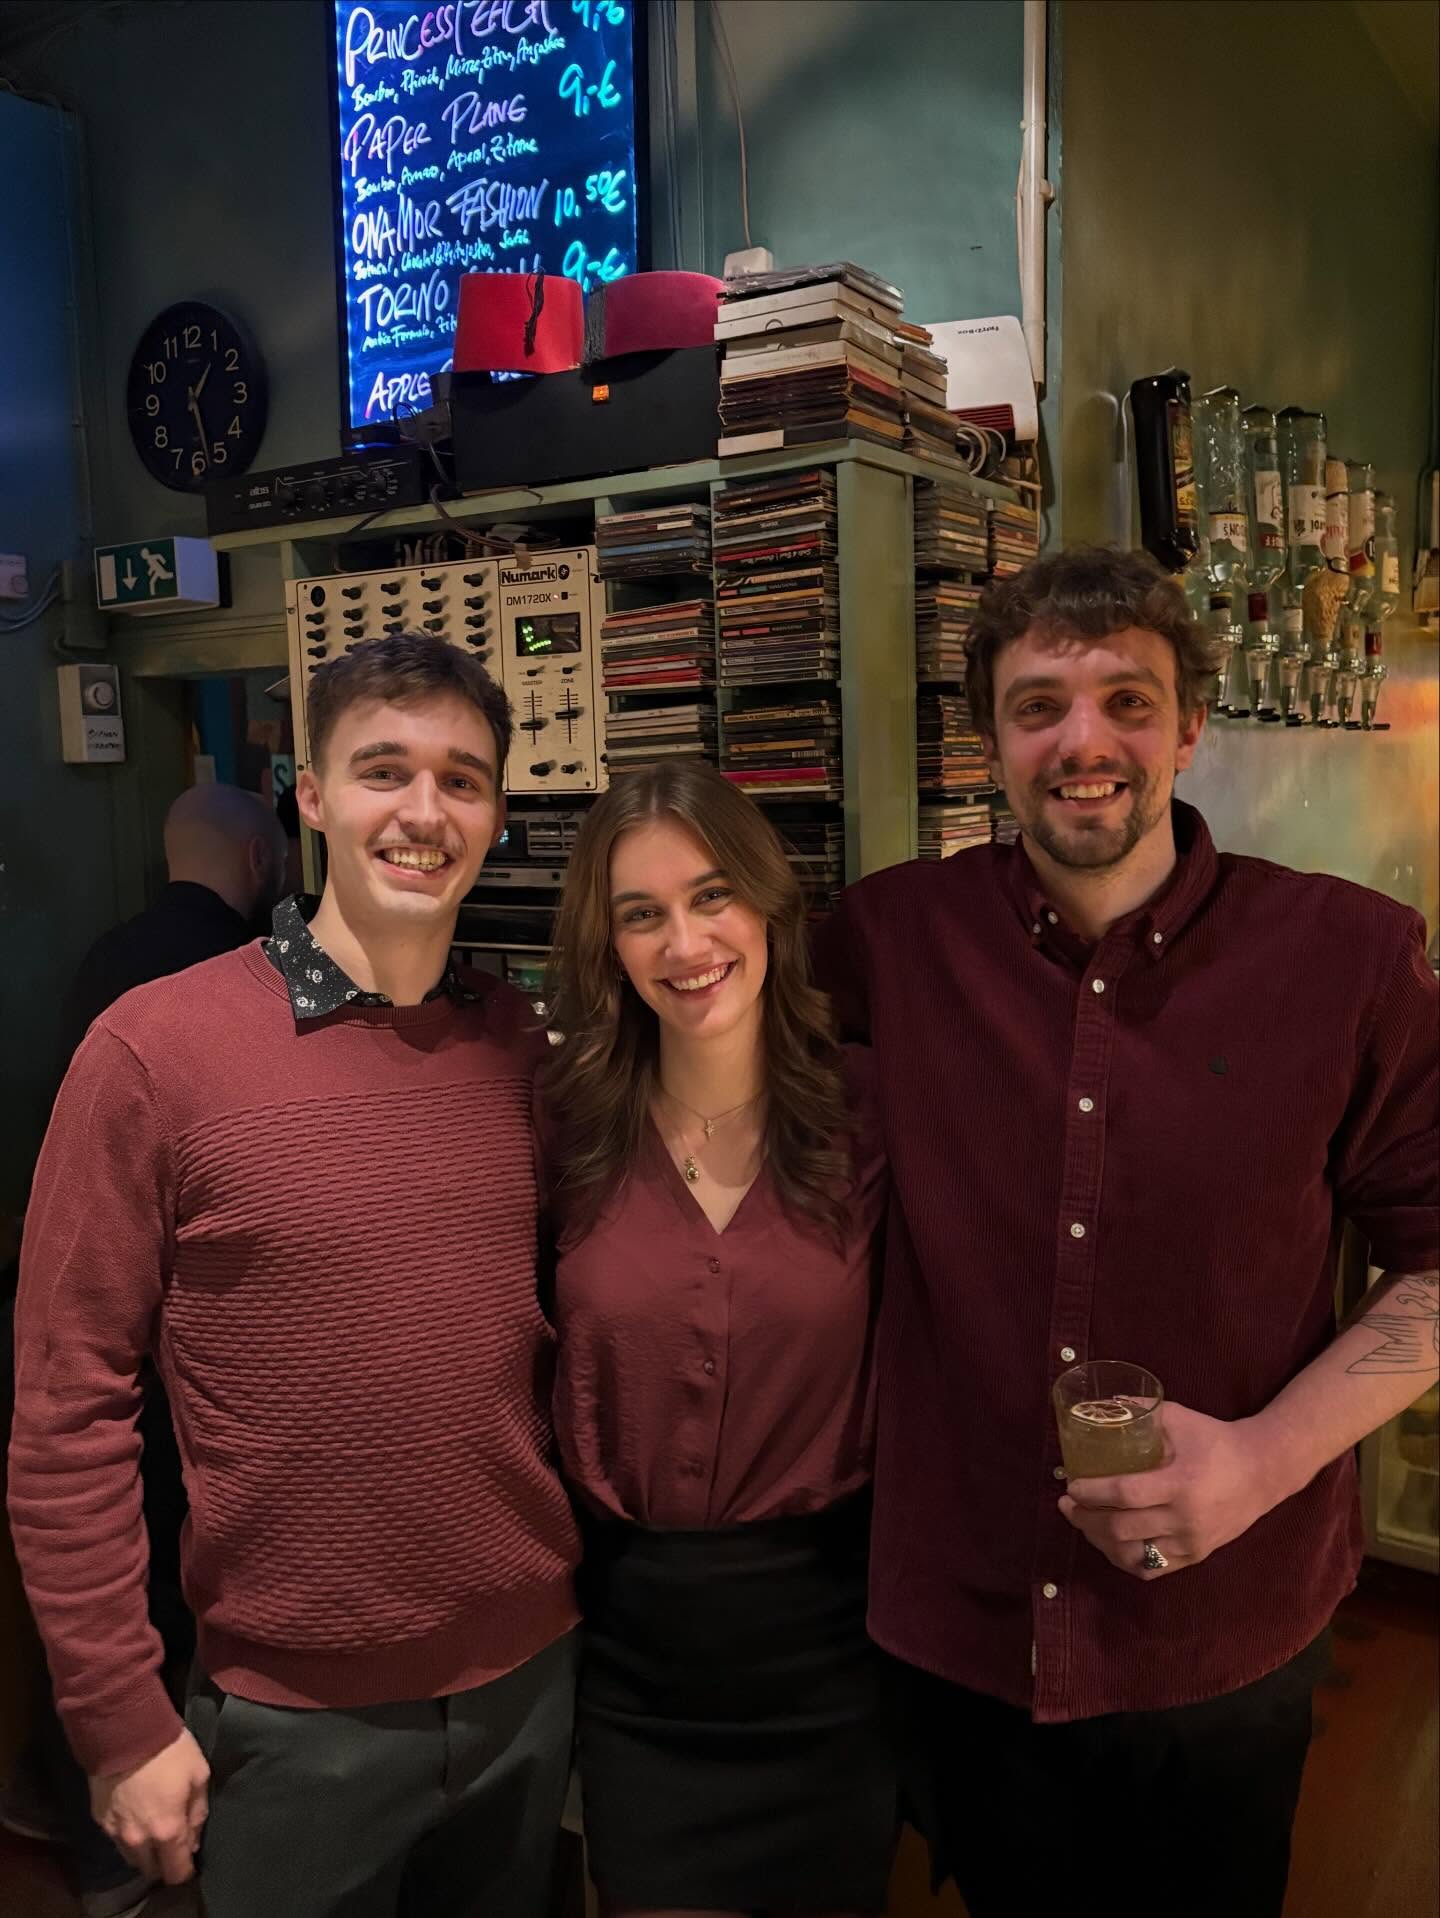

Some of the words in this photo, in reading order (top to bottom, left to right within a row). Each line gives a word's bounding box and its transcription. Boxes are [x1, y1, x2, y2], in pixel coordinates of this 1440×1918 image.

[344, 113, 432, 178] PAPER
[441, 91, 529, 145] PLANE
[446, 177, 550, 236] FASHION
[357, 269, 449, 332] TORINO
[164, 337, 178, 360] 11
[183, 326, 202, 349] 12
[210, 330, 218, 352] 1
[224, 349, 239, 372] 2
[148, 361, 166, 385] 10
[233, 382, 248, 404] 3
[364, 371, 432, 419] APPLE
[146, 394, 160, 416] 9
[155, 426, 169, 448] 8
[228, 416, 242, 439] 4
[171, 448, 184, 470] 7
[191, 451, 206, 474] 6
[213, 442, 228, 464] 5
[501, 567, 556, 584] Numark
